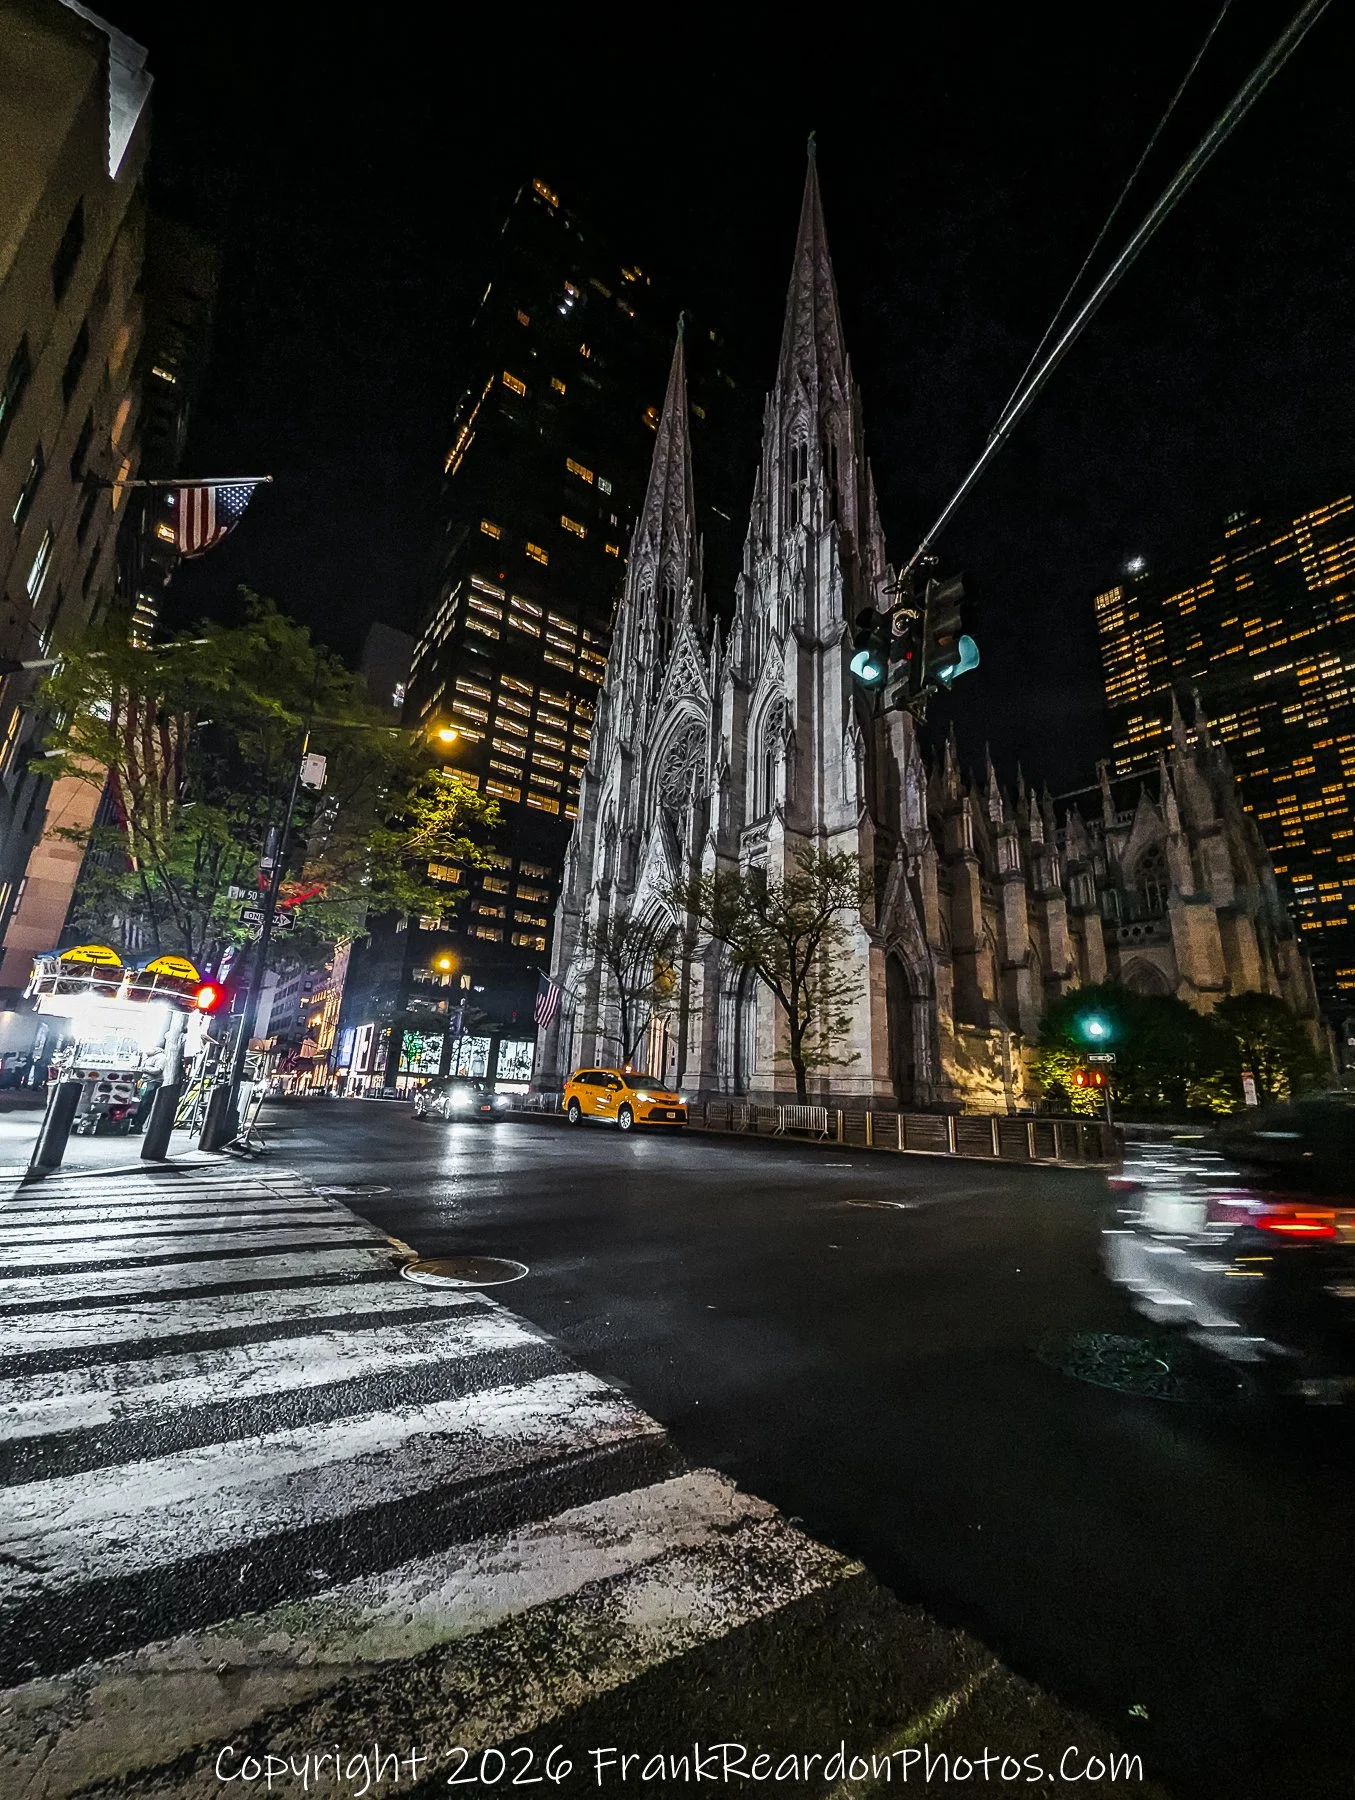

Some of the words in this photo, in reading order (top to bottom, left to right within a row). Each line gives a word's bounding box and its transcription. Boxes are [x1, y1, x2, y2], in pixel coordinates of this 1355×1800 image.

[239, 889, 245, 899] W
[247, 890, 258, 900] 50
[248, 911, 265, 921] ONE
